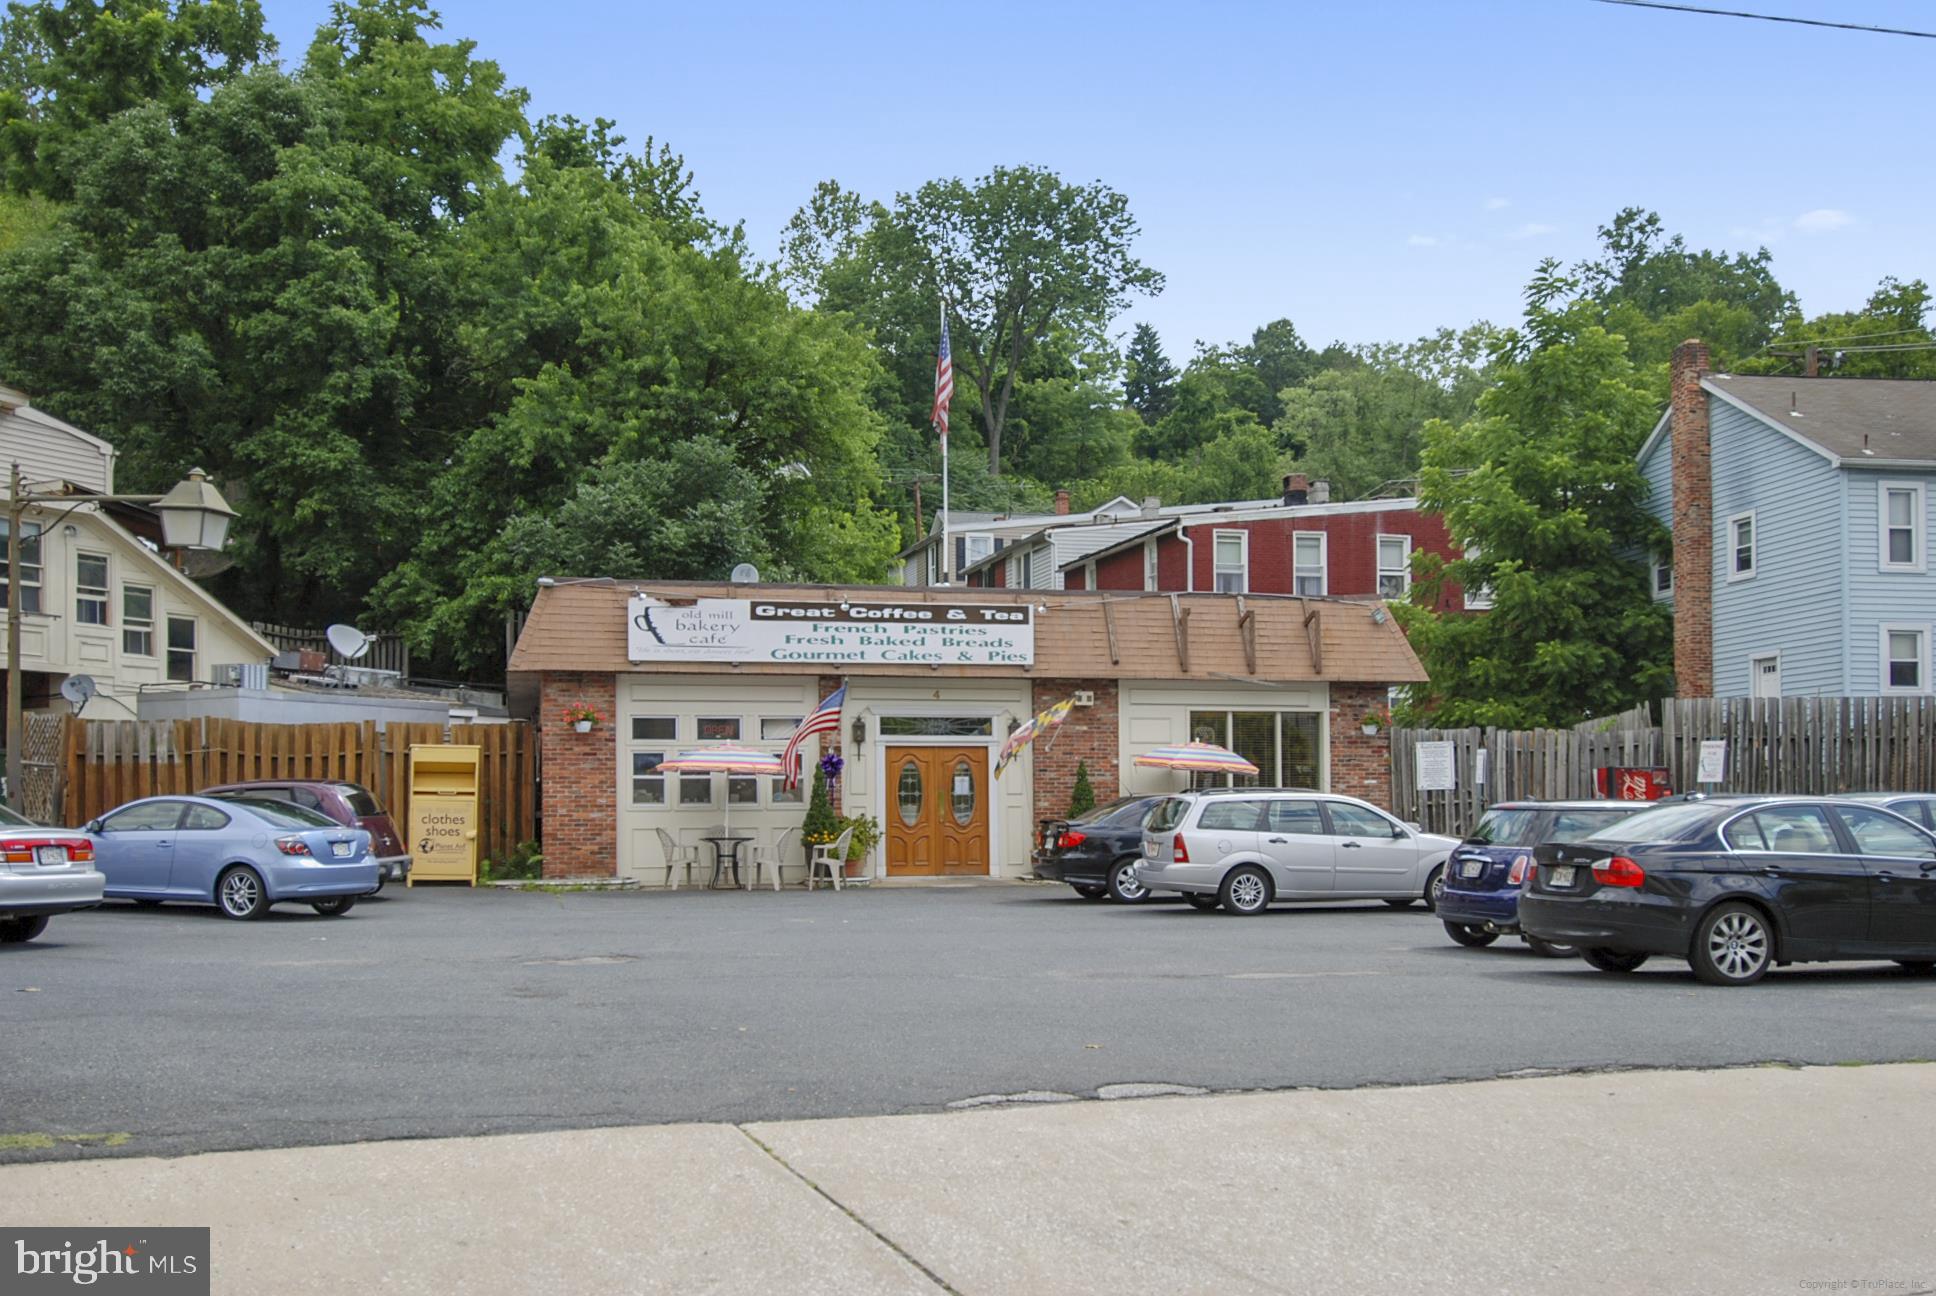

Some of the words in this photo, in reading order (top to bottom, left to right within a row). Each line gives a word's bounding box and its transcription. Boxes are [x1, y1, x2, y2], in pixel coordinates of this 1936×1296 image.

[681, 610, 702, 620] old
[708, 611, 733, 620] mill
[756, 605, 835, 618] Great
[849, 606, 932, 620] Coffee
[946, 608, 967, 620] &
[980, 609, 1025, 621] Tea
[675, 619, 741, 634] bakery
[812, 623, 887, 634] French
[903, 624, 987, 636] Pastries
[784, 634, 844, 646] Fresh
[859, 635, 926, 647] Baked
[942, 637, 1013, 648] Breads
[770, 648, 866, 662] Gourmet
[881, 649, 943, 662] Cakes
[957, 650, 972, 662] &
[988, 650, 1028, 662] Pies
[932, 689, 941, 702] 4
[421, 813, 465, 825] clothes
[425, 825, 461, 837] shoes
